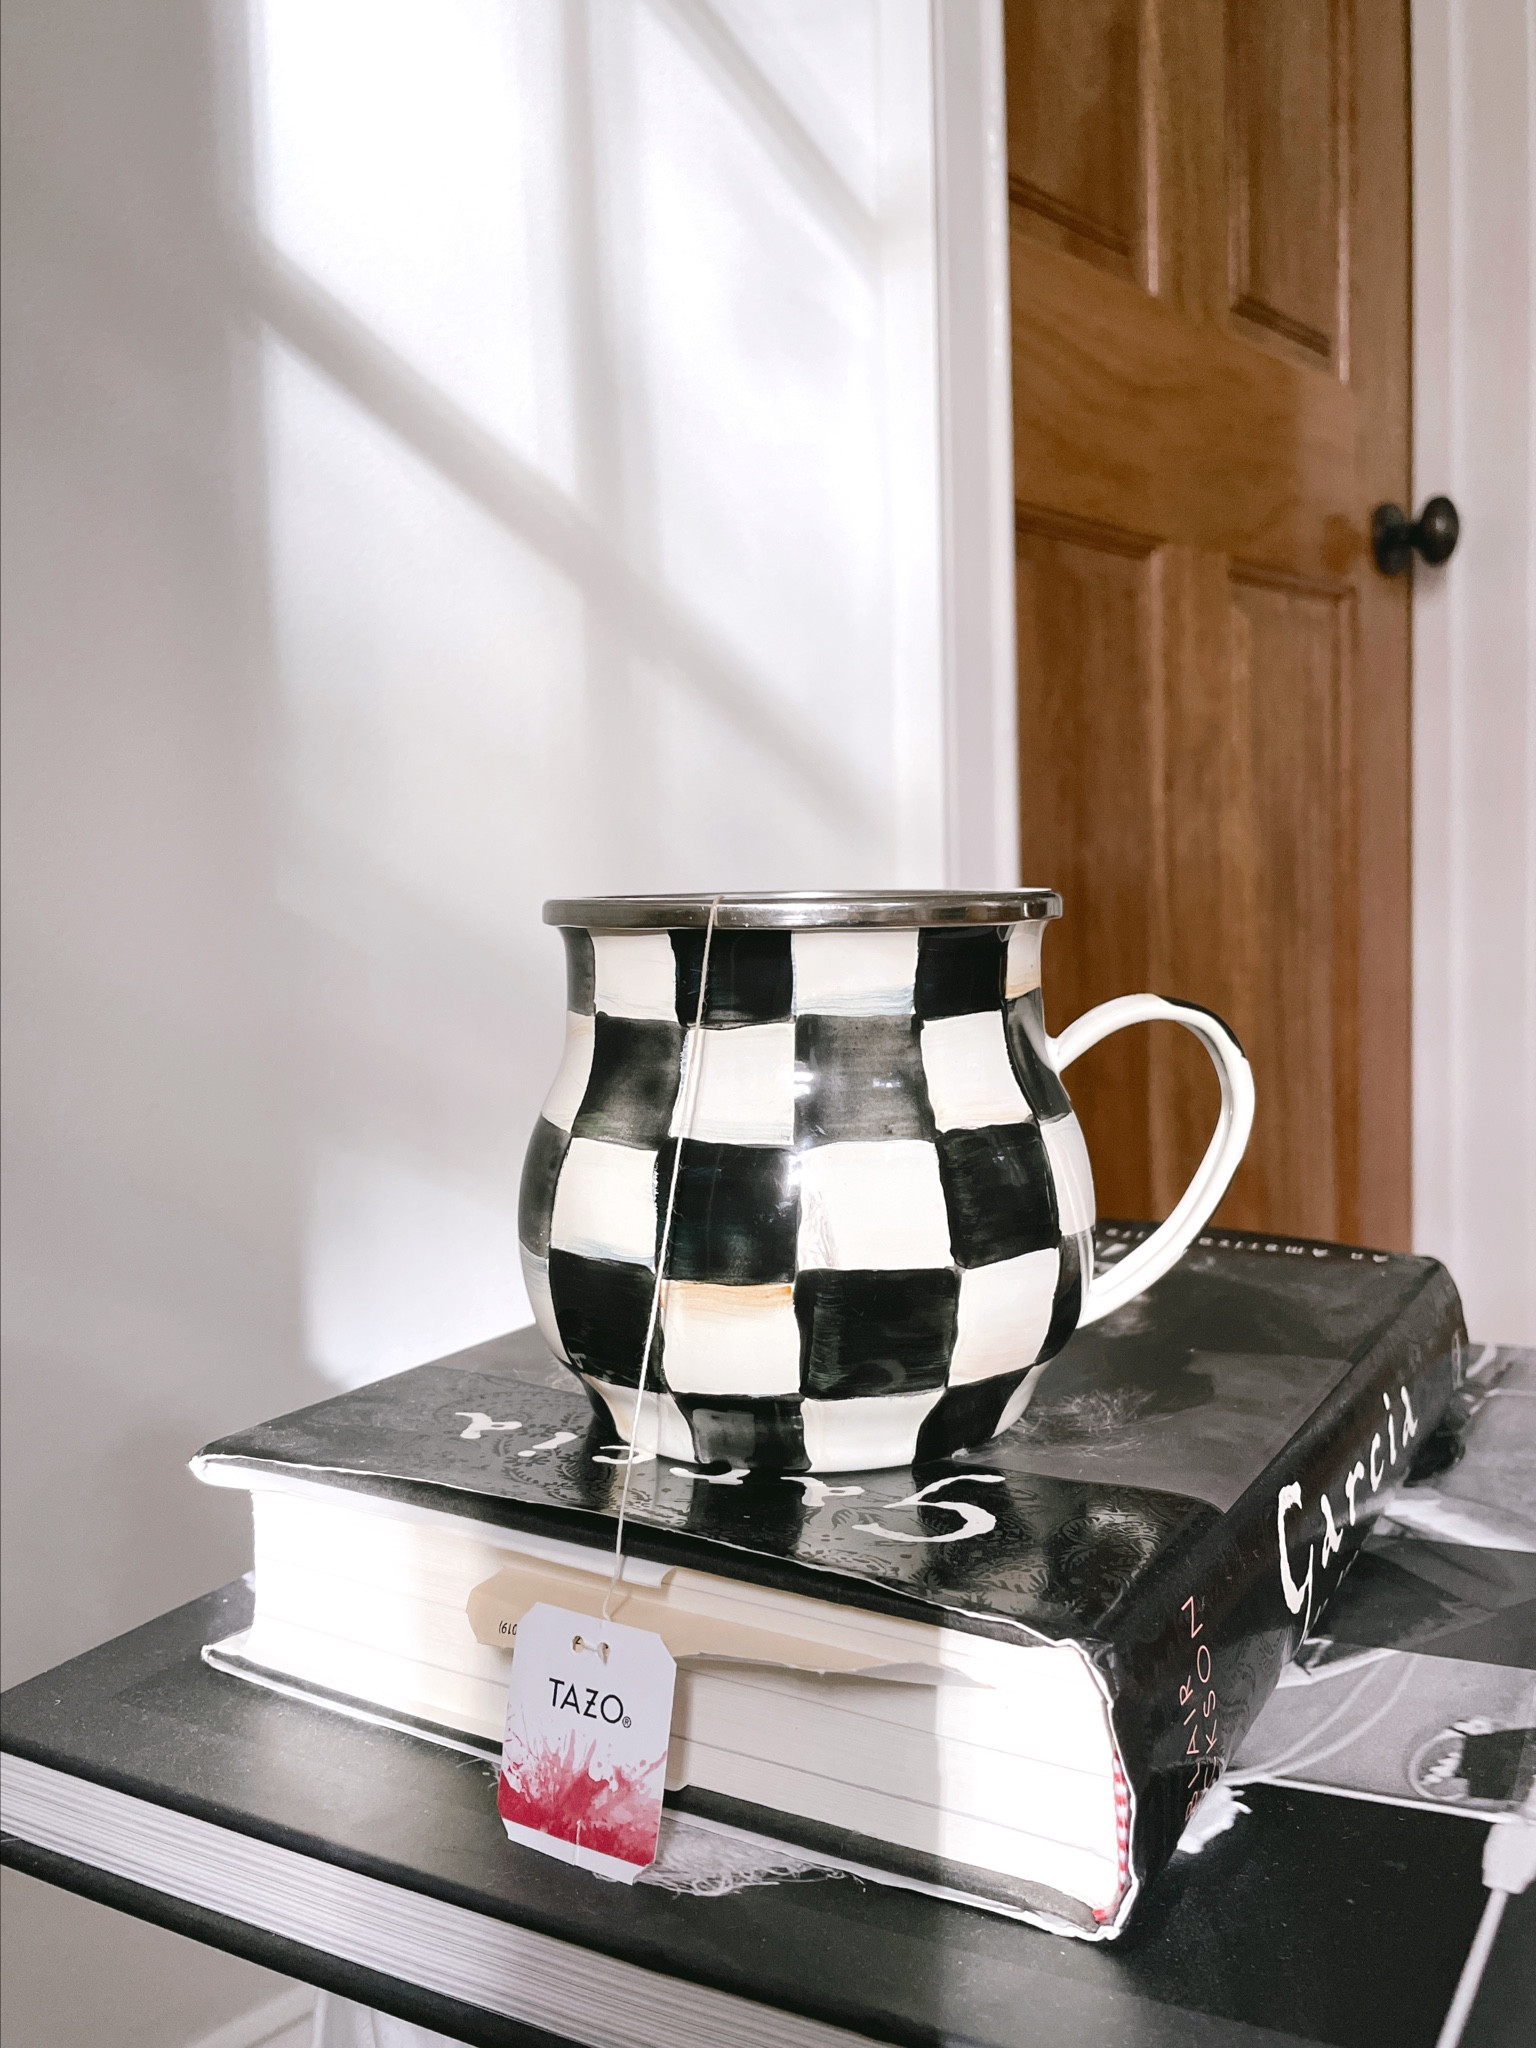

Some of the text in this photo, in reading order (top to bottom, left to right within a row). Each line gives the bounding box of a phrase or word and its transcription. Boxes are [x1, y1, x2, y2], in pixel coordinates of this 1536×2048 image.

[1198, 1236, 1329, 1257] America
[1278, 1386, 1419, 1661] Garcia
[1180, 1596, 1218, 1790] CKSON
